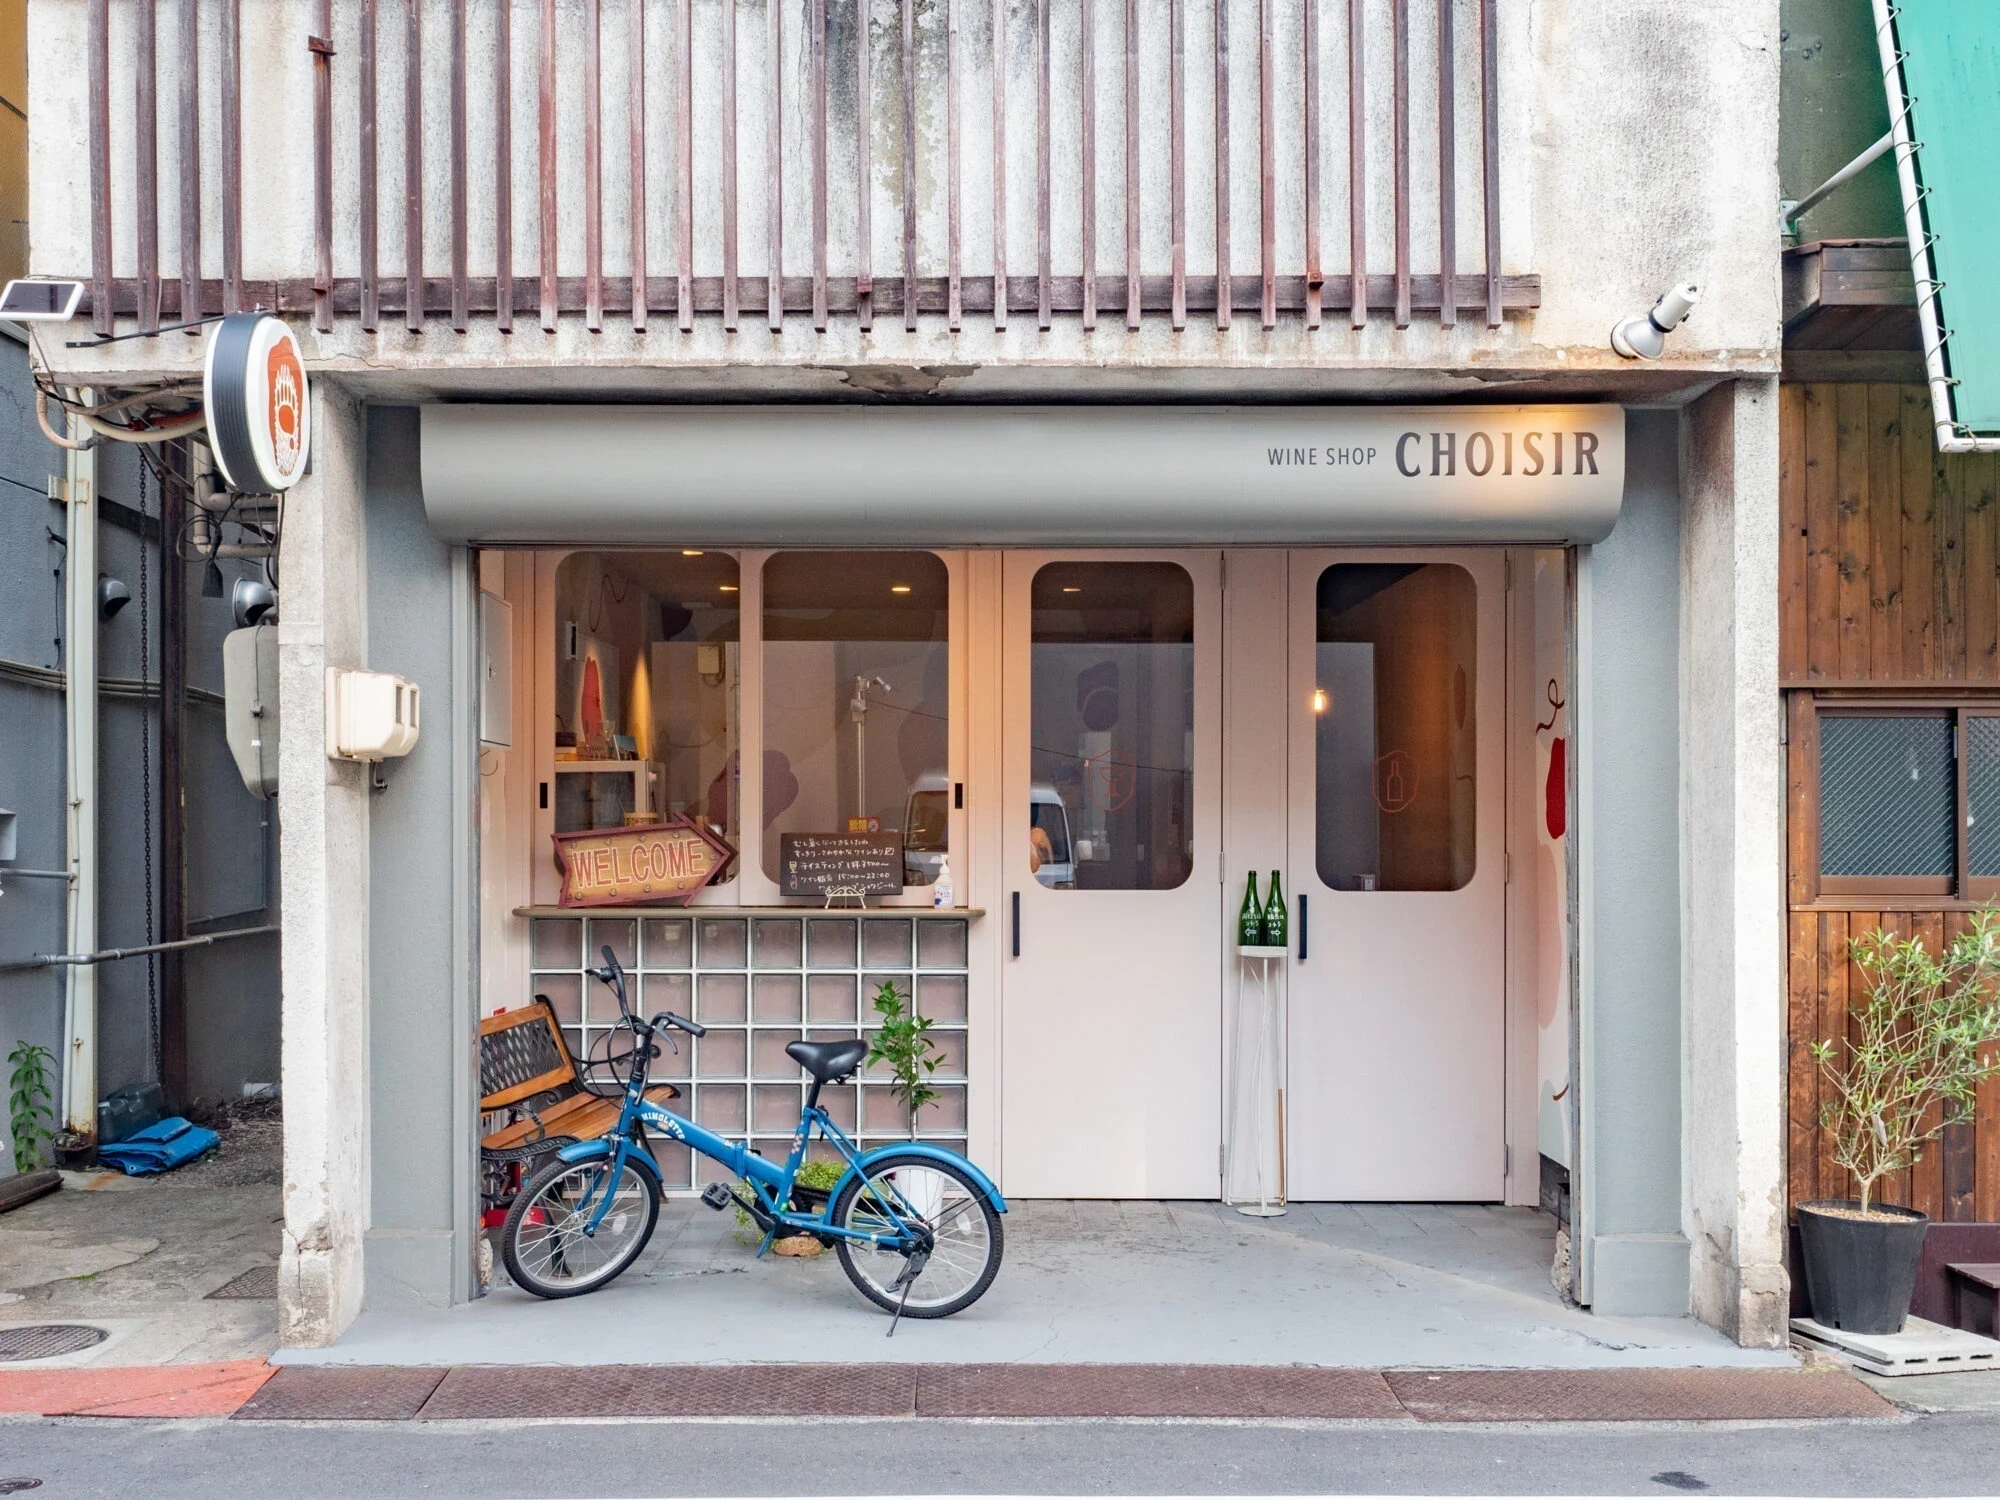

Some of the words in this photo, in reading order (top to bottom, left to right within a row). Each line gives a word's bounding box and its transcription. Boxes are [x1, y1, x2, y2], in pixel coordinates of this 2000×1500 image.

[1267, 447, 1318, 466] WINE
[1326, 447, 1377, 466] SHOP
[1395, 431, 1600, 478] CHOISIR
[571, 838, 707, 889] WELCOME
[641, 1111, 686, 1140] MIMOLETTE
